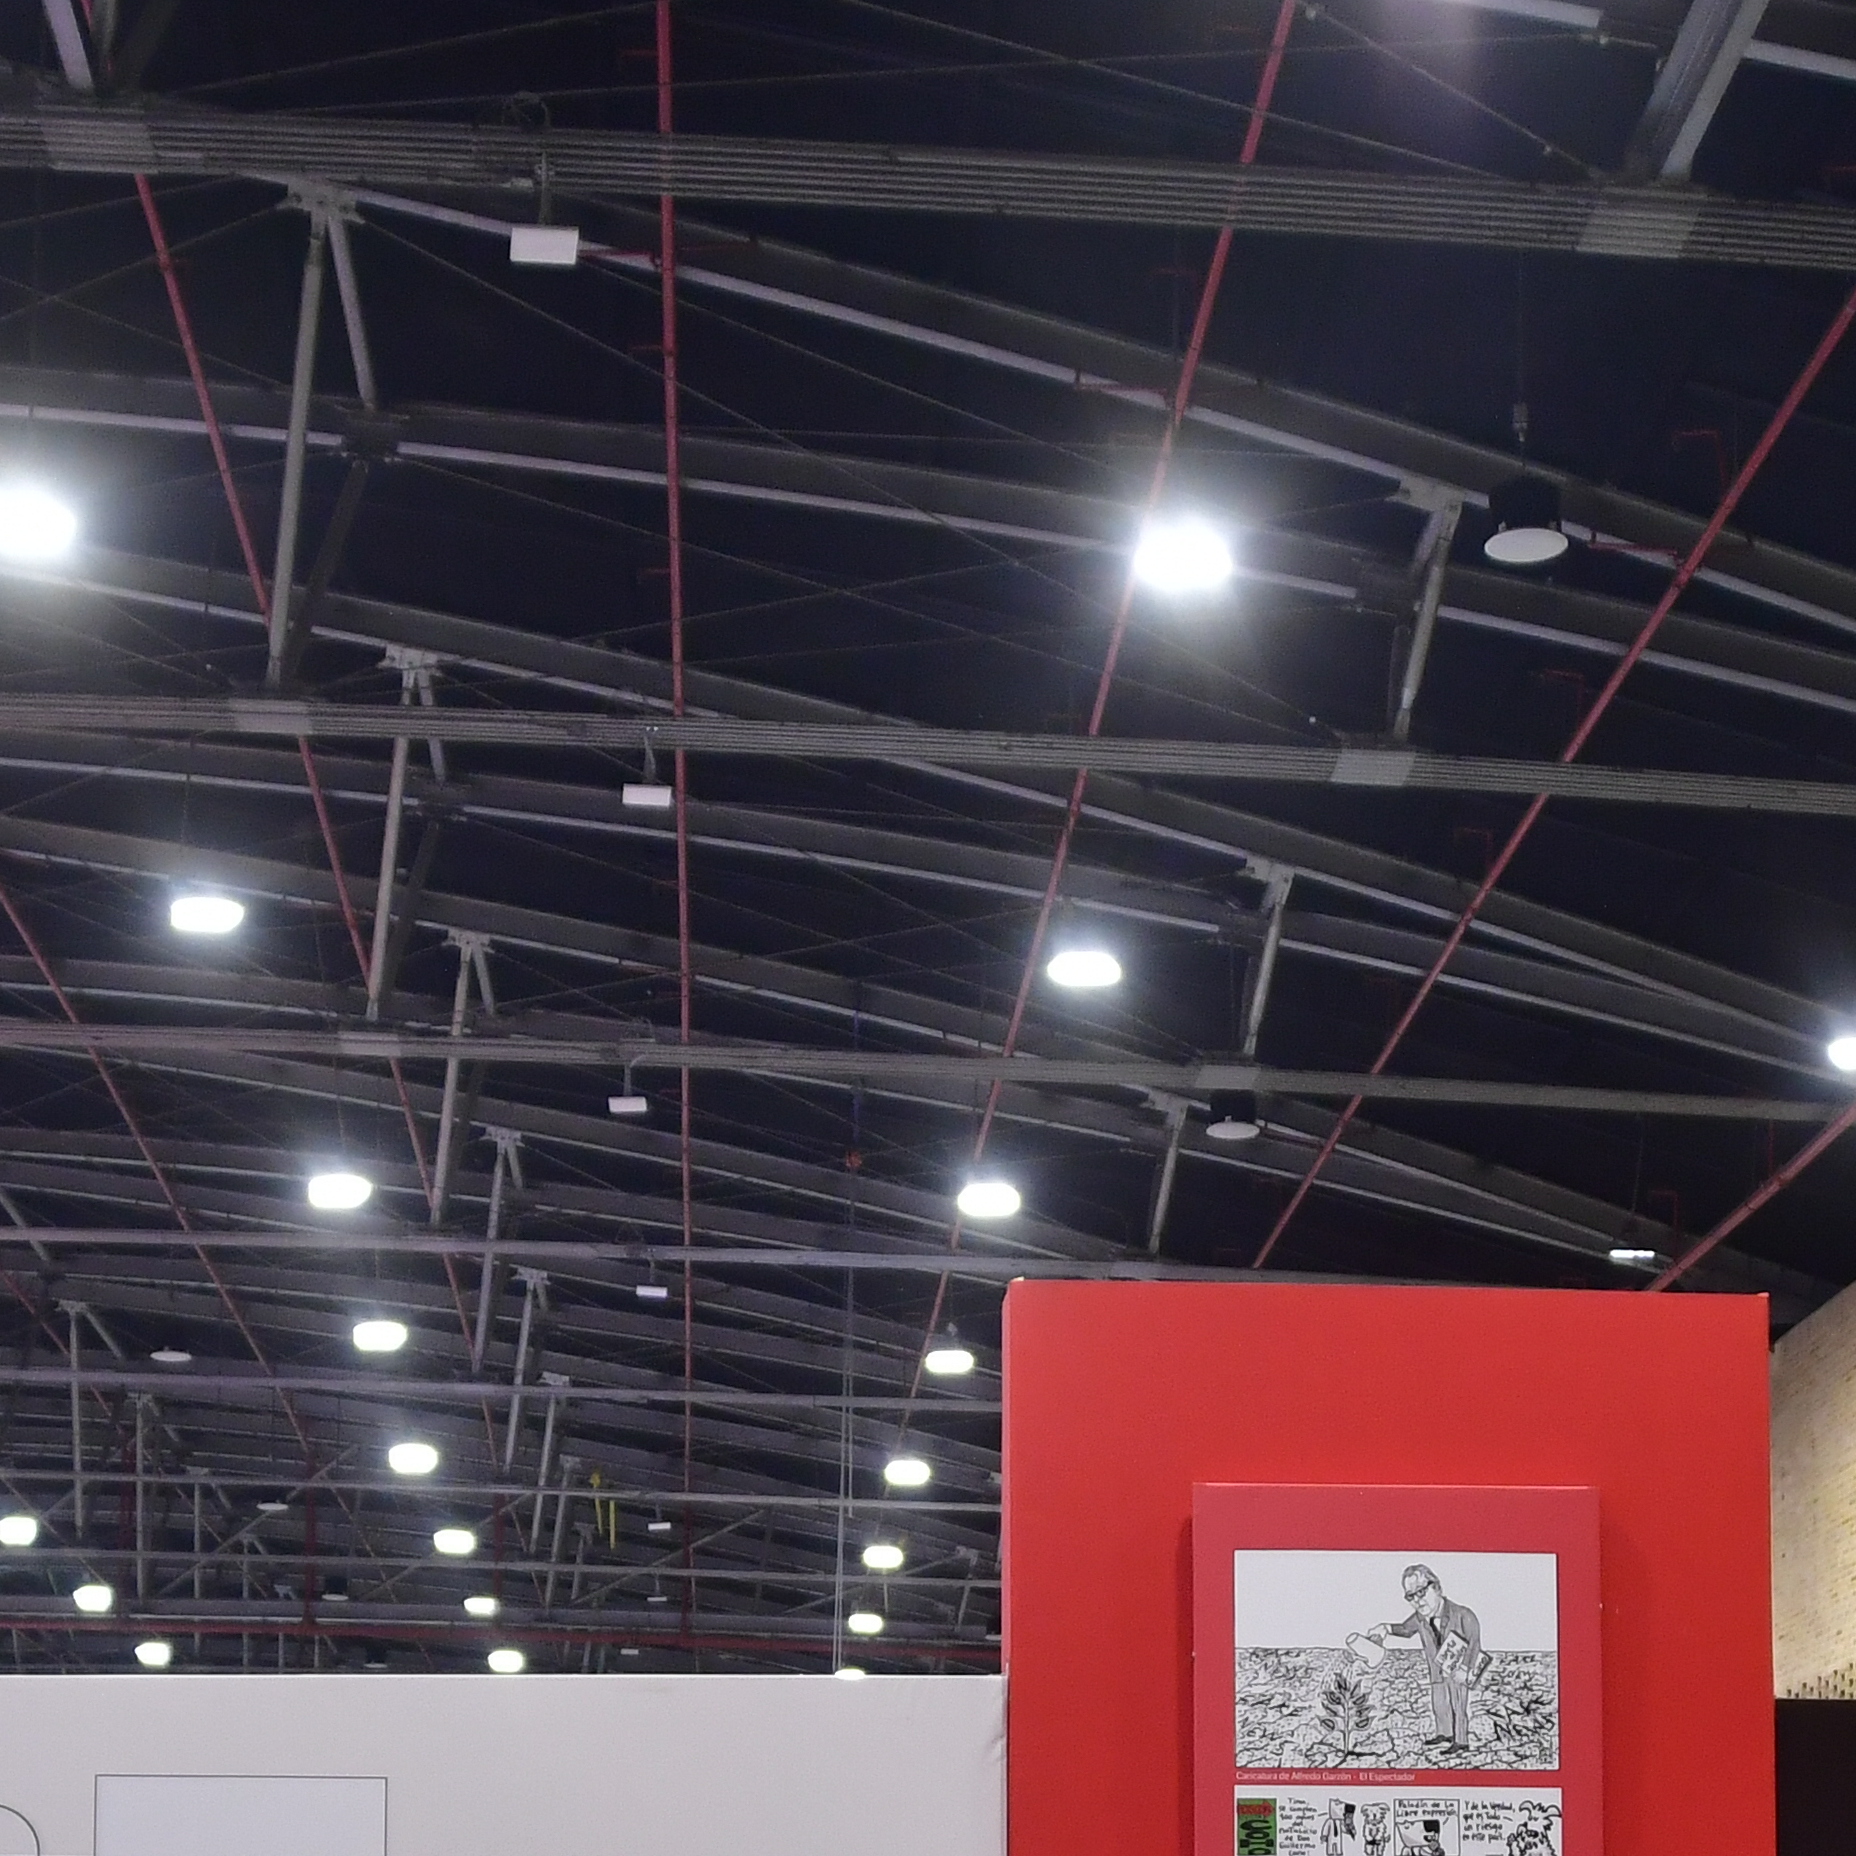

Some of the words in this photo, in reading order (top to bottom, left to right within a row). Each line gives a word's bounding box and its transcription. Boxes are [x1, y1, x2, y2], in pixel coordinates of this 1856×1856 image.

[1236, 1771, 1277, 1780] Caricatura
[1278, 1772, 1289, 1780] de
[1290, 1771, 1320, 1780] Alfredo
[1359, 1772, 1367, 1780] El
[1368, 1772, 1414, 1781] Espectador
